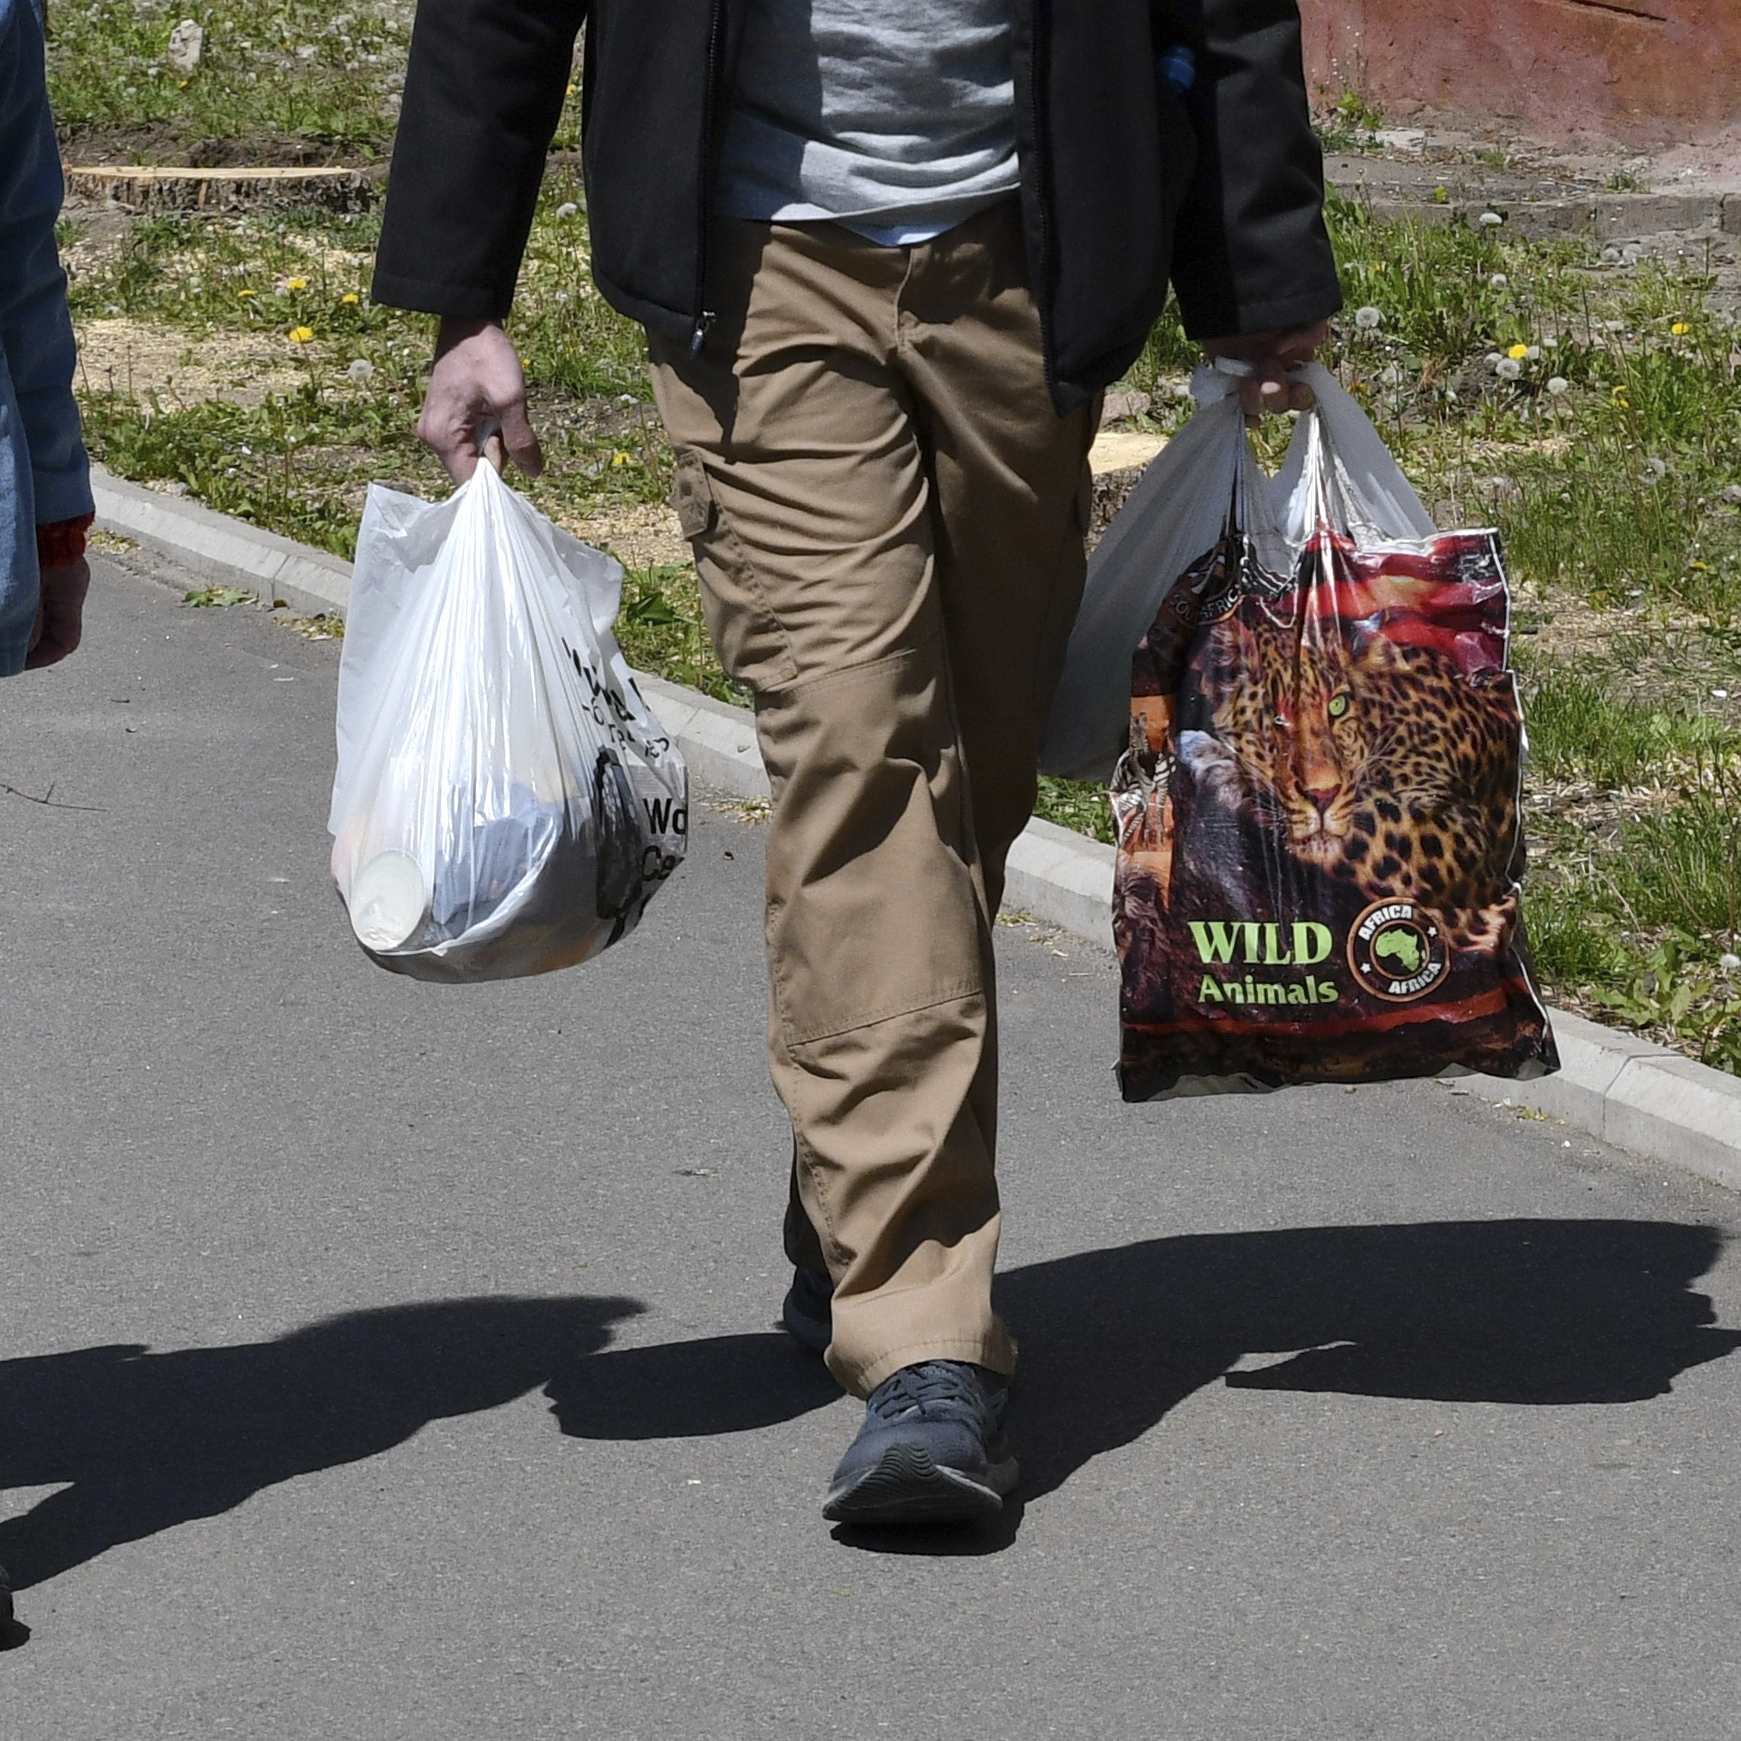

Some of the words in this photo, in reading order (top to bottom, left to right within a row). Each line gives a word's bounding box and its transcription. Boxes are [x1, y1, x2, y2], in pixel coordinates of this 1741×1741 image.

[1358, 904, 1414, 941] AFRICA
[1187, 920, 1334, 965] WILD
[1196, 973, 1340, 1005] Animals
[1387, 960, 1443, 995] AFRICA
